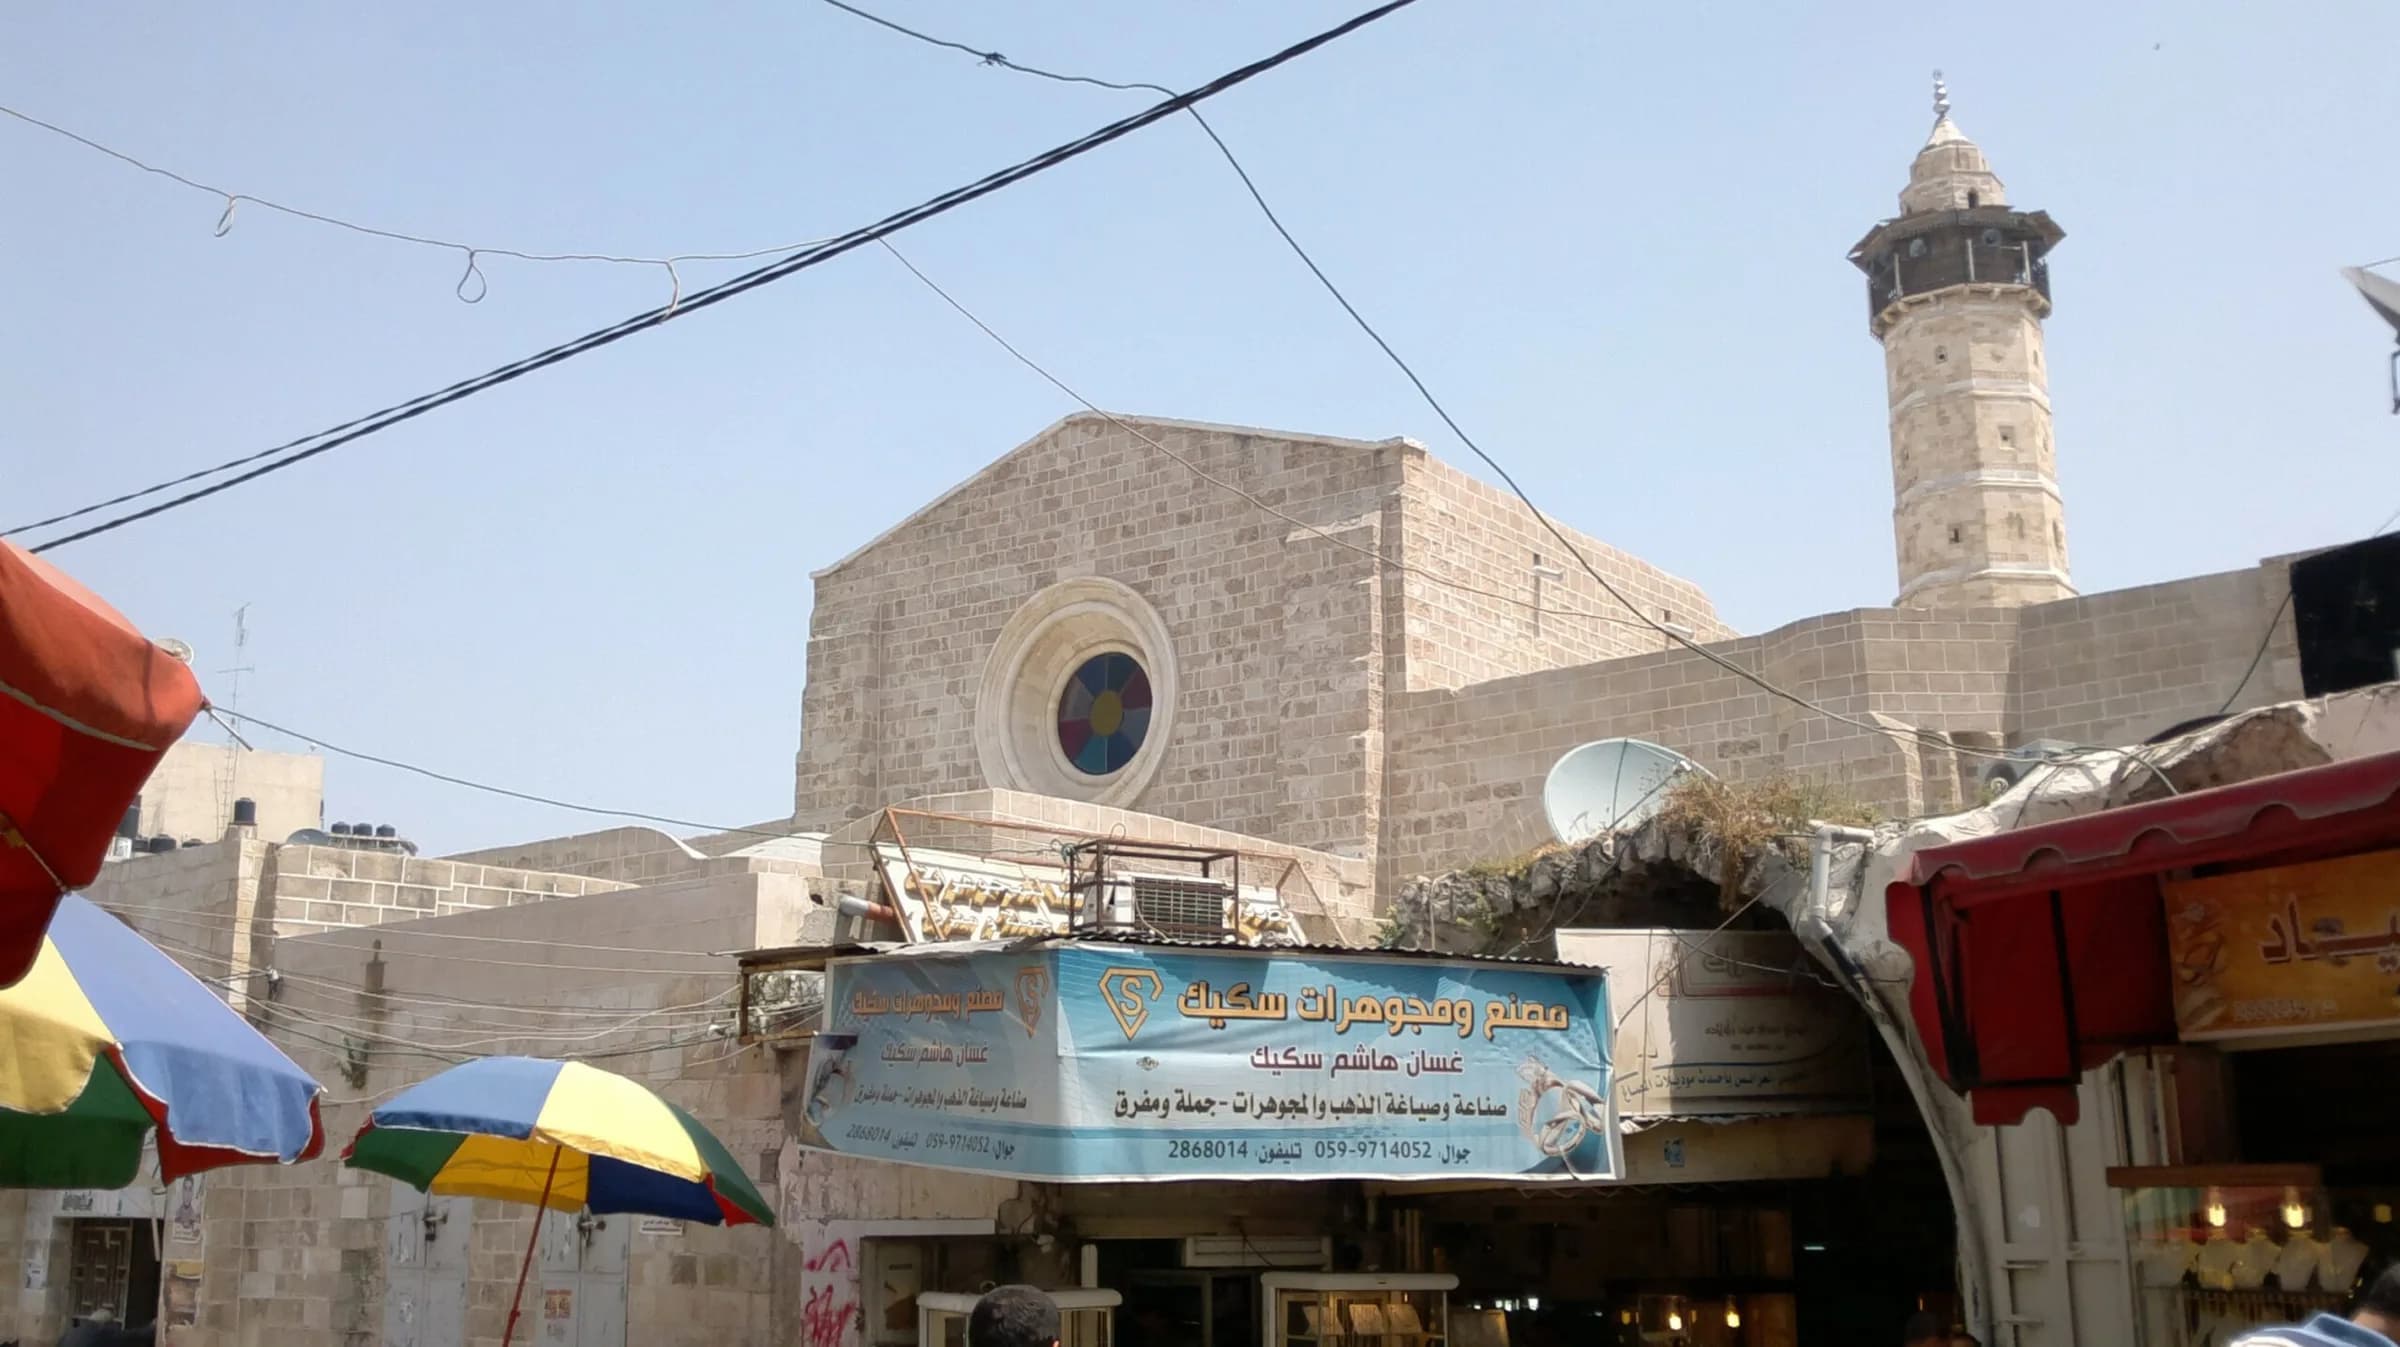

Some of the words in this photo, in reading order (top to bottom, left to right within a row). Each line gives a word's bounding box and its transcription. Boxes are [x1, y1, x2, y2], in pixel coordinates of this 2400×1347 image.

[852, 989, 889, 1020] سكيك
[893, 989, 961, 1023] ومجوهرات
[965, 984, 1005, 1022] مصنع
[1177, 980, 1288, 1030] سكيك
[1296, 985, 1474, 1039] ومجوهرات
[1483, 992, 1569, 1042] مصنع
[881, 1041, 916, 1067] سكيك
[917, 1040, 953, 1068] هاشم
[956, 1041, 988, 1067] غسان
[1250, 1046, 1323, 1076] سكيك
[1330, 1044, 1398, 1078] هاشم
[1406, 1050, 1465, 1078] غسان
[944, 1088, 968, 1111] الذهب
[969, 1086, 998, 1112] وصياغة
[1000, 1087, 1027, 1109] صناعة
[1115, 1089, 1170, 1119] ومفرق
[1233, 1092, 1326, 1120] والمجوهرات
[1330, 1093, 1381, 1120] الذهب
[1385, 1092, 1450, 1122] وصياغة
[1453, 1093, 1507, 1116] صناعة
[846, 1123, 892, 1141] 2868014
[926, 1132, 990, 1153] 059-9714052
[1168, 1140, 1248, 1159] 2868014
[1315, 1140, 1432, 1160] 059-9714052
